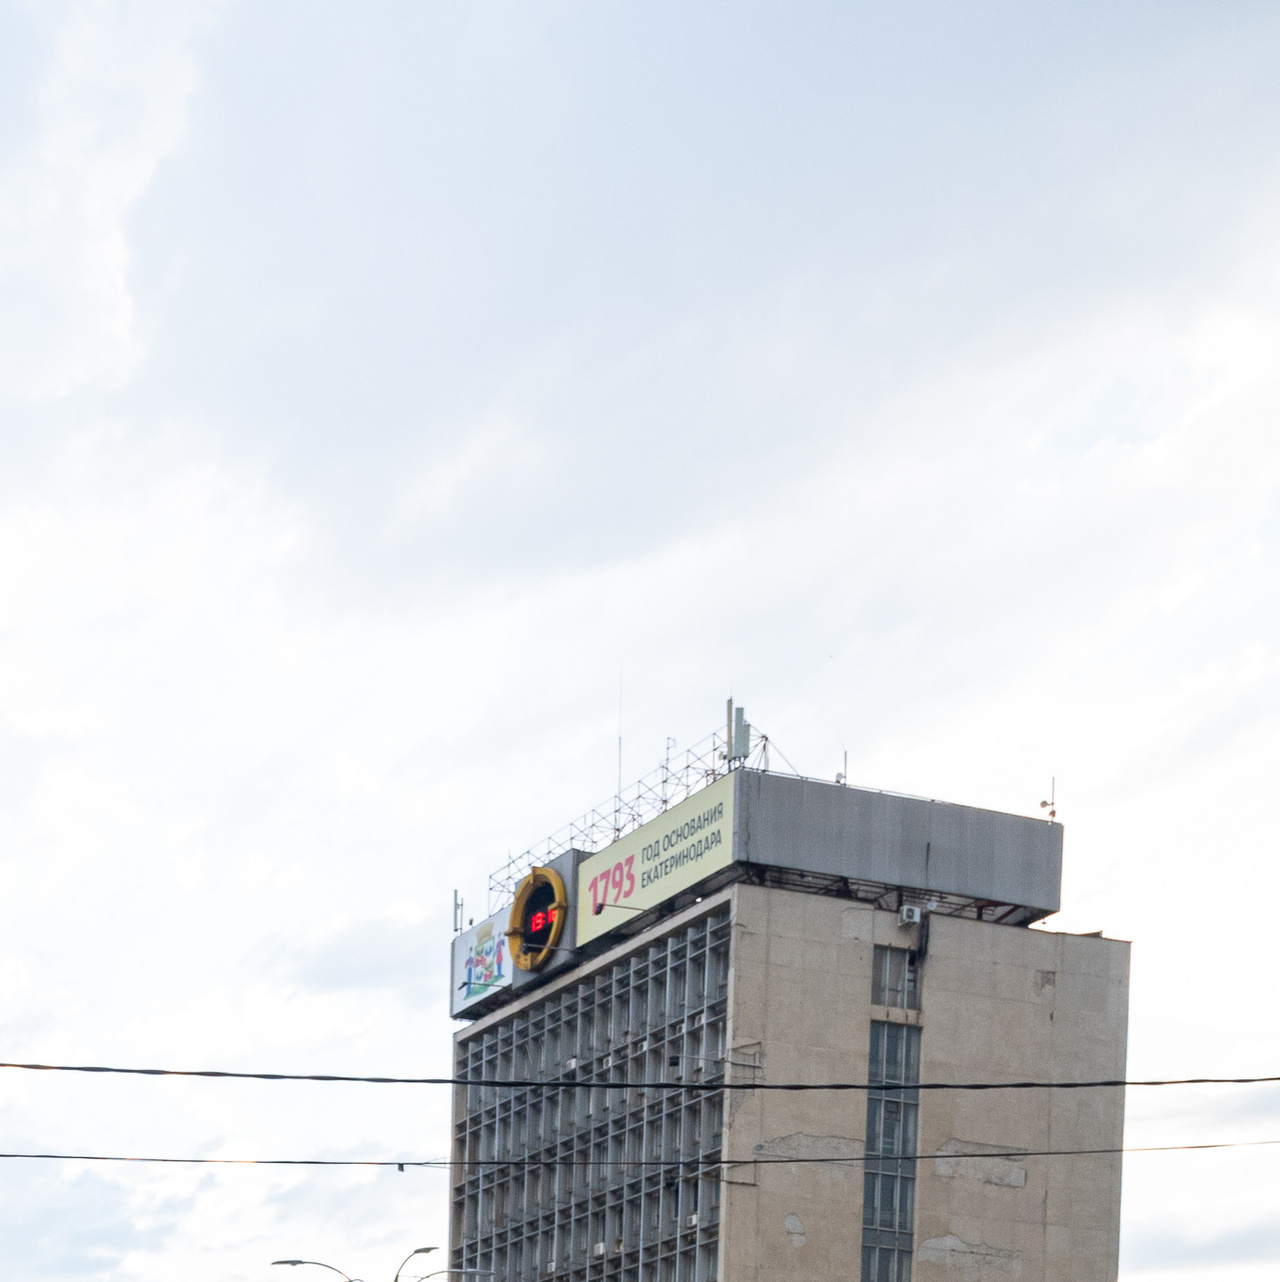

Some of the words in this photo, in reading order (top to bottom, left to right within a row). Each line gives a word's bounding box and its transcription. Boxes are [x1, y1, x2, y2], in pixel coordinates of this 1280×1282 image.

[641, 839, 660, 865] ГОД
[662, 802, 724, 852] ОСНОВАНИЯ
[641, 829, 723, 889] ЕКАТЕРИНОДАРА
[588, 854, 636, 916] 1793
